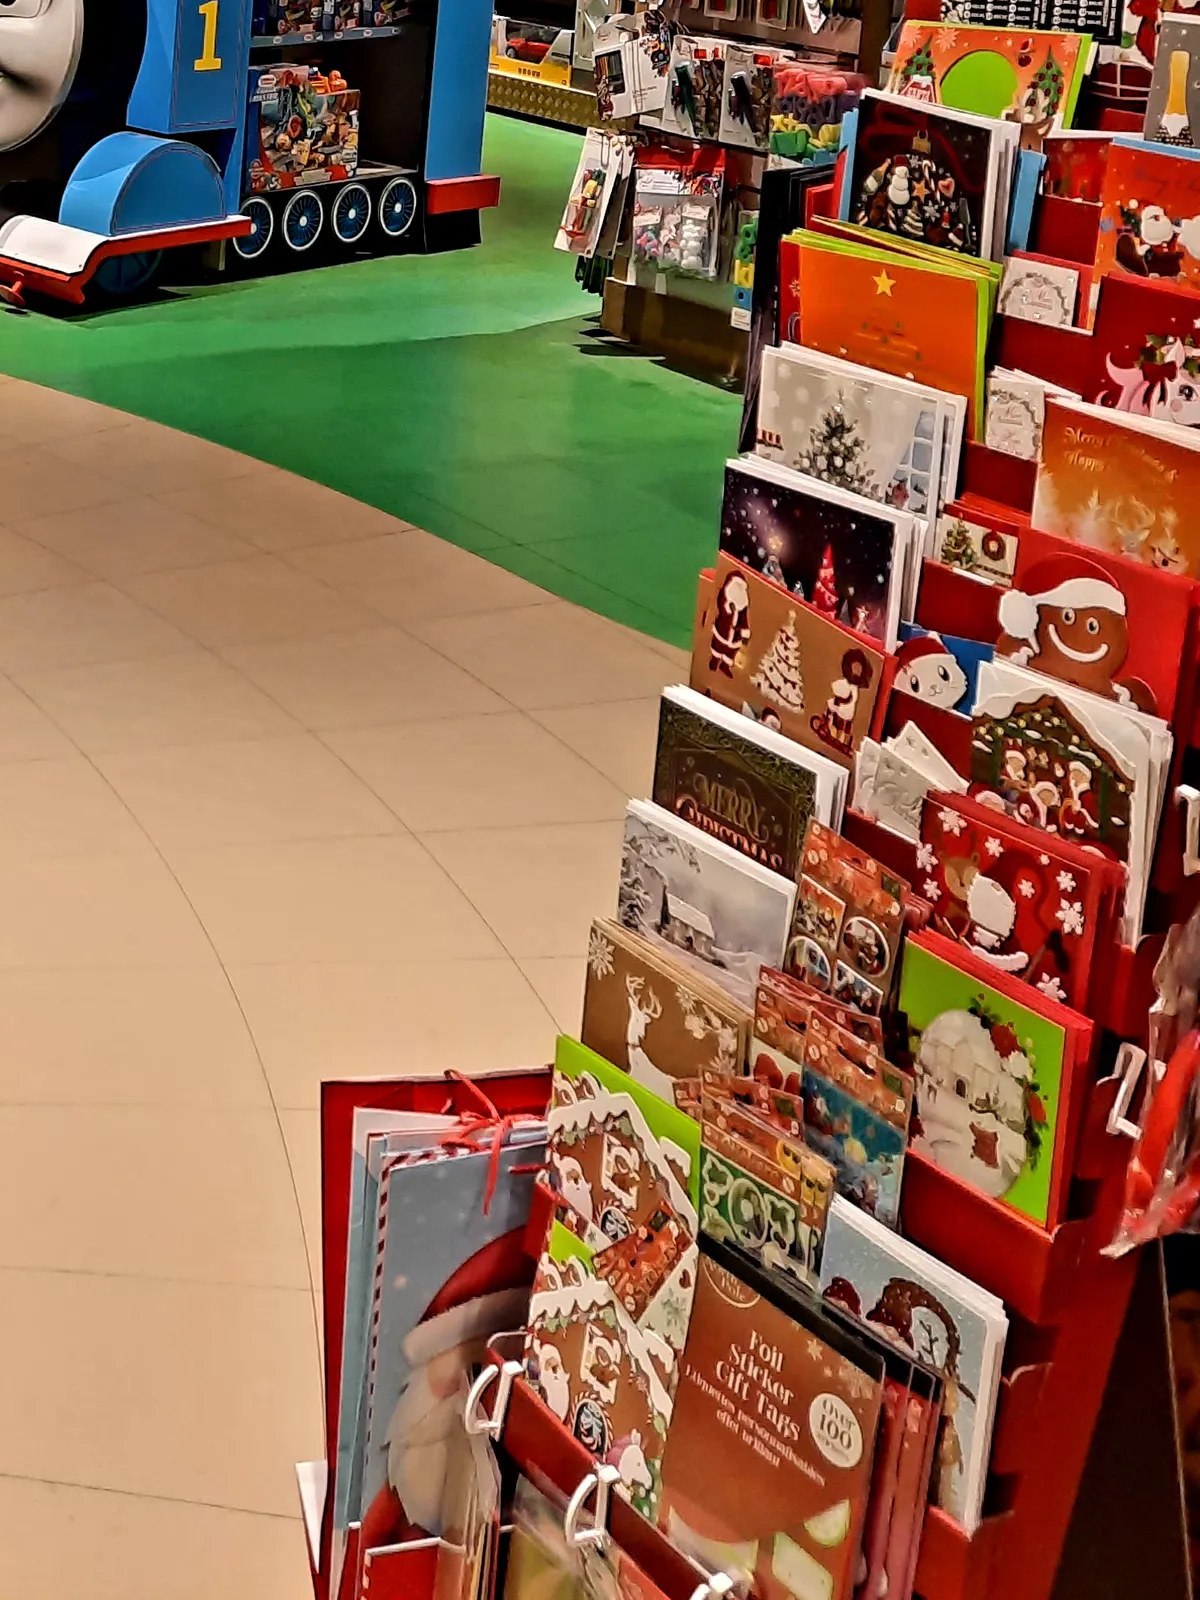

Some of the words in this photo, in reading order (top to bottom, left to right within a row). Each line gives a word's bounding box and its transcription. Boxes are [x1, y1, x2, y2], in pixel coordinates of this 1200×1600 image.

[194, 0, 222, 72] 1
[693, 772, 769, 844] MERRY
[729, 1343, 795, 1406] Sticker
[749, 1329, 784, 1374] Foil
[715, 1360, 750, 1401] Gift
[756, 1390, 801, 1441] Tags
[820, 1413, 852, 1449] 100
[823, 1399, 856, 1431] Over
